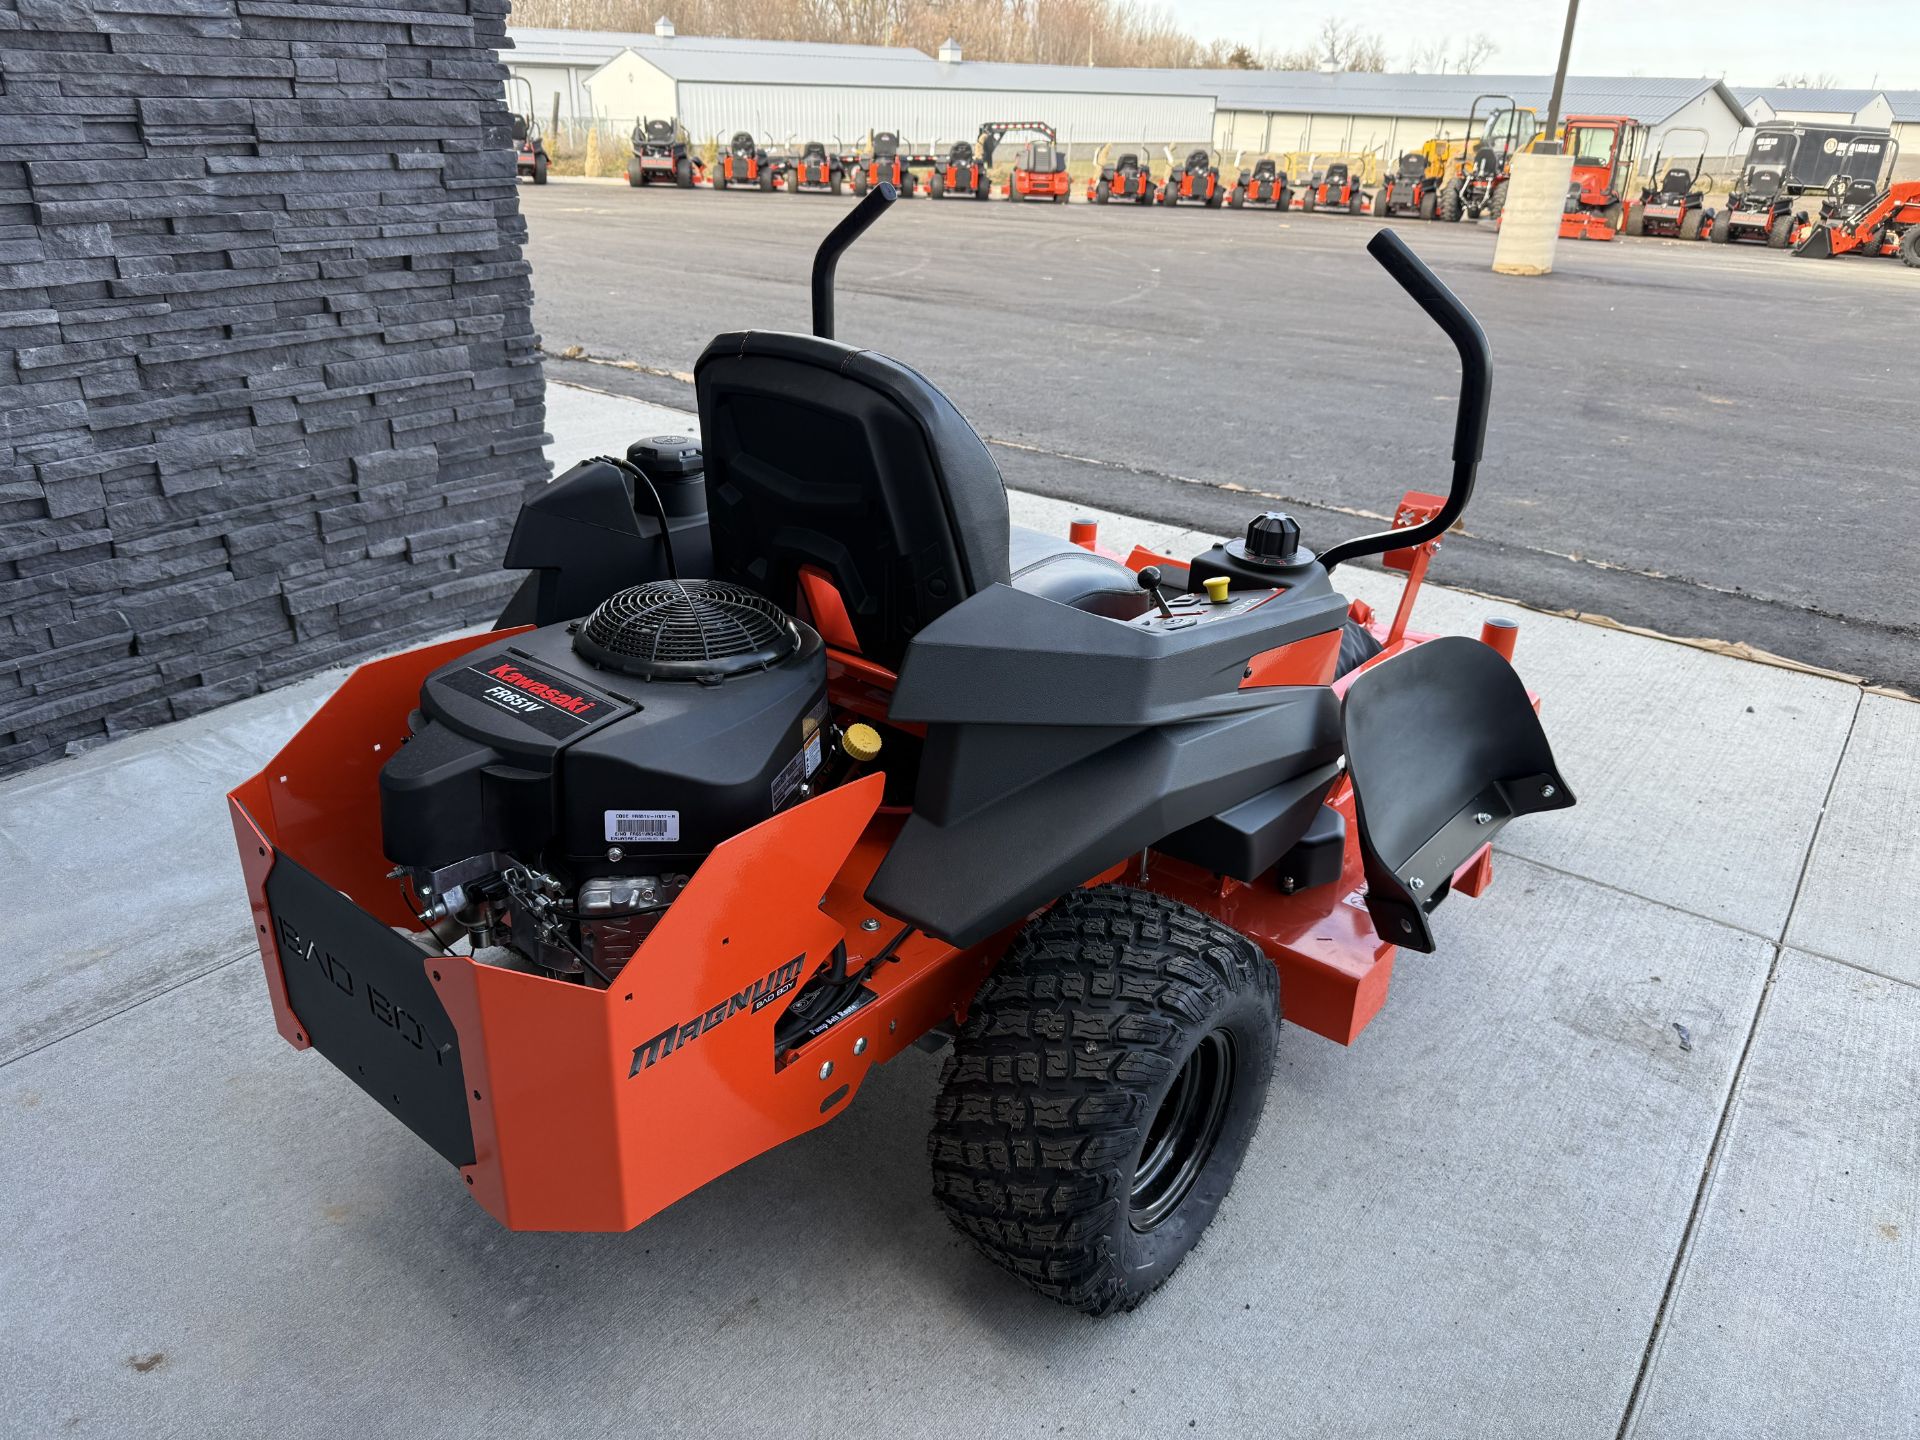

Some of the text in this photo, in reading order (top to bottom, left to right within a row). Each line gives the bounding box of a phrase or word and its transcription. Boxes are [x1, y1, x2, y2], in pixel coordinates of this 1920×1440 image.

[484, 686, 545, 712] FR651V
[487, 664, 596, 714] Kawasaki
[277, 915, 453, 1066] BAD BOY
[756, 981, 795, 1010] BAD BOY
[628, 951, 807, 1080] MAGNUM
[809, 1004, 858, 1036] Pump Belt Route
